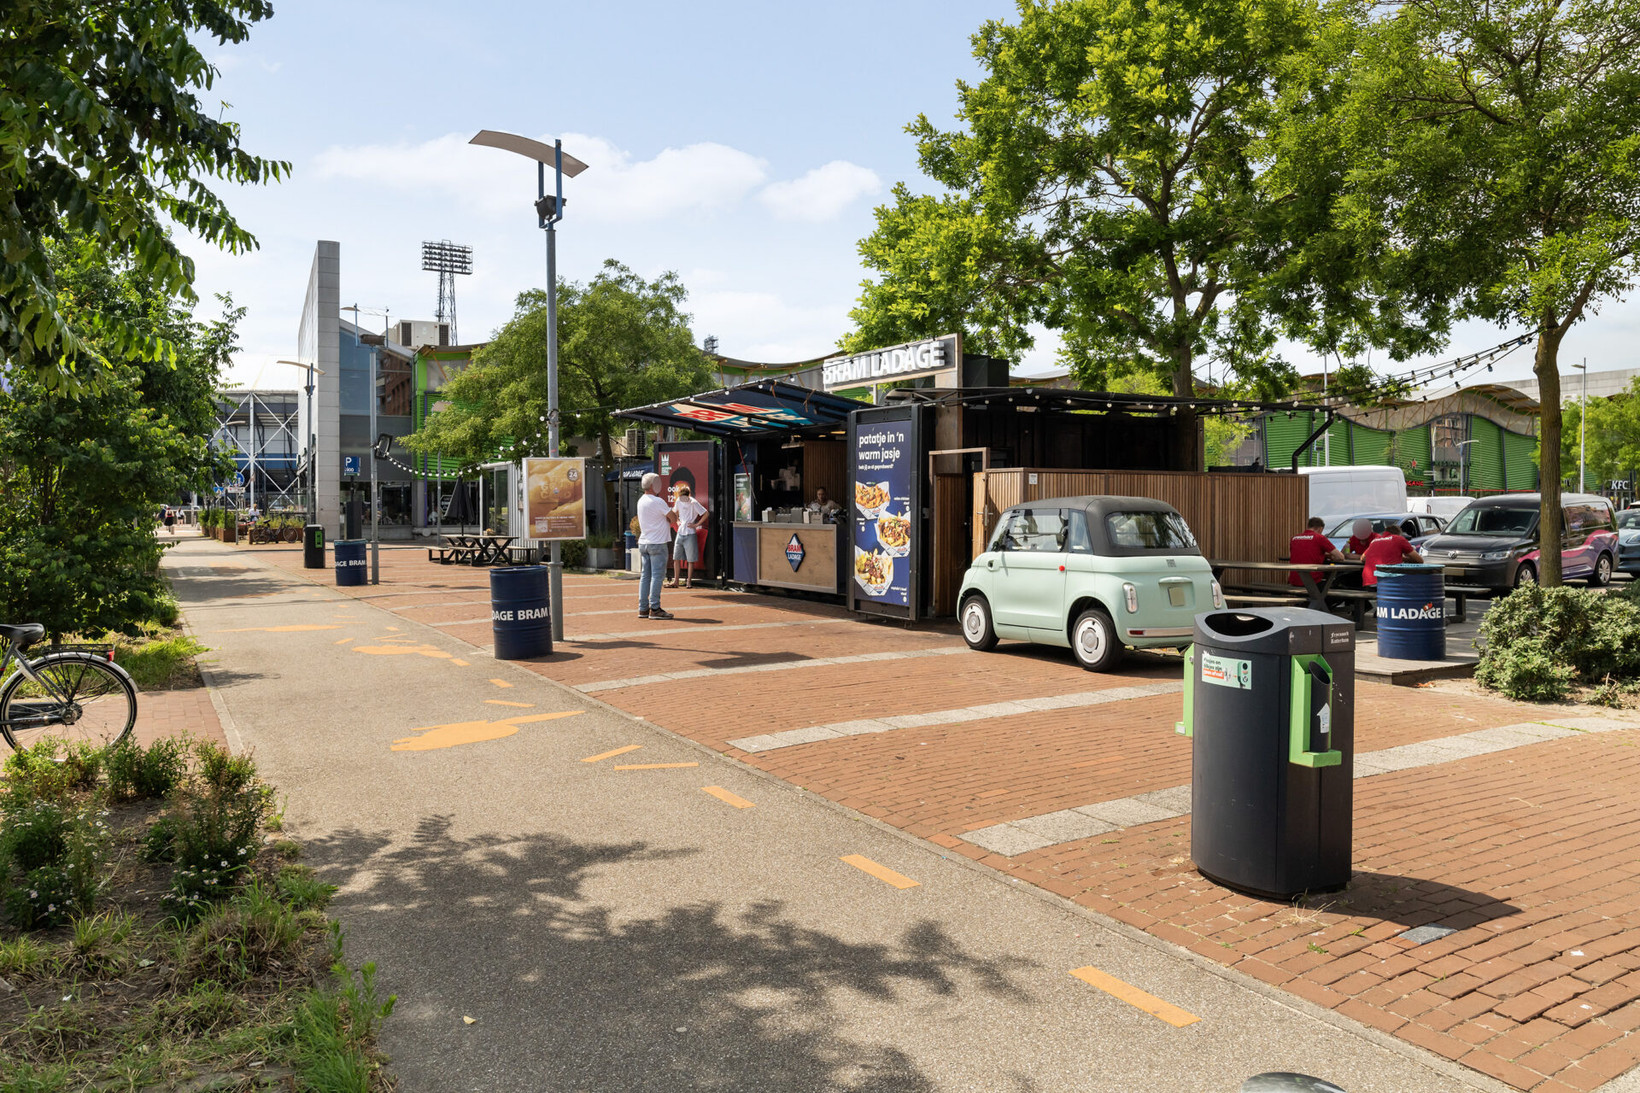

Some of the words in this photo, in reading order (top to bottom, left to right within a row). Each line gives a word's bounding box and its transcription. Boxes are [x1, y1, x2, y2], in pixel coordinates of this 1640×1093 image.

[822, 355, 870, 384] BRAM
[870, 340, 945, 377] LADAGE
[858, 432, 886, 448] patatje
[887, 431, 895, 443] in
[346, 457, 352, 467] P
[858, 450, 880, 460] warm
[881, 447, 900, 463] jasje
[1611, 480, 1629, 490] KFC
[788, 543, 802, 552] BRAM
[517, 606, 549, 621] BRAM
[1391, 606, 1441, 620] LADAGE
